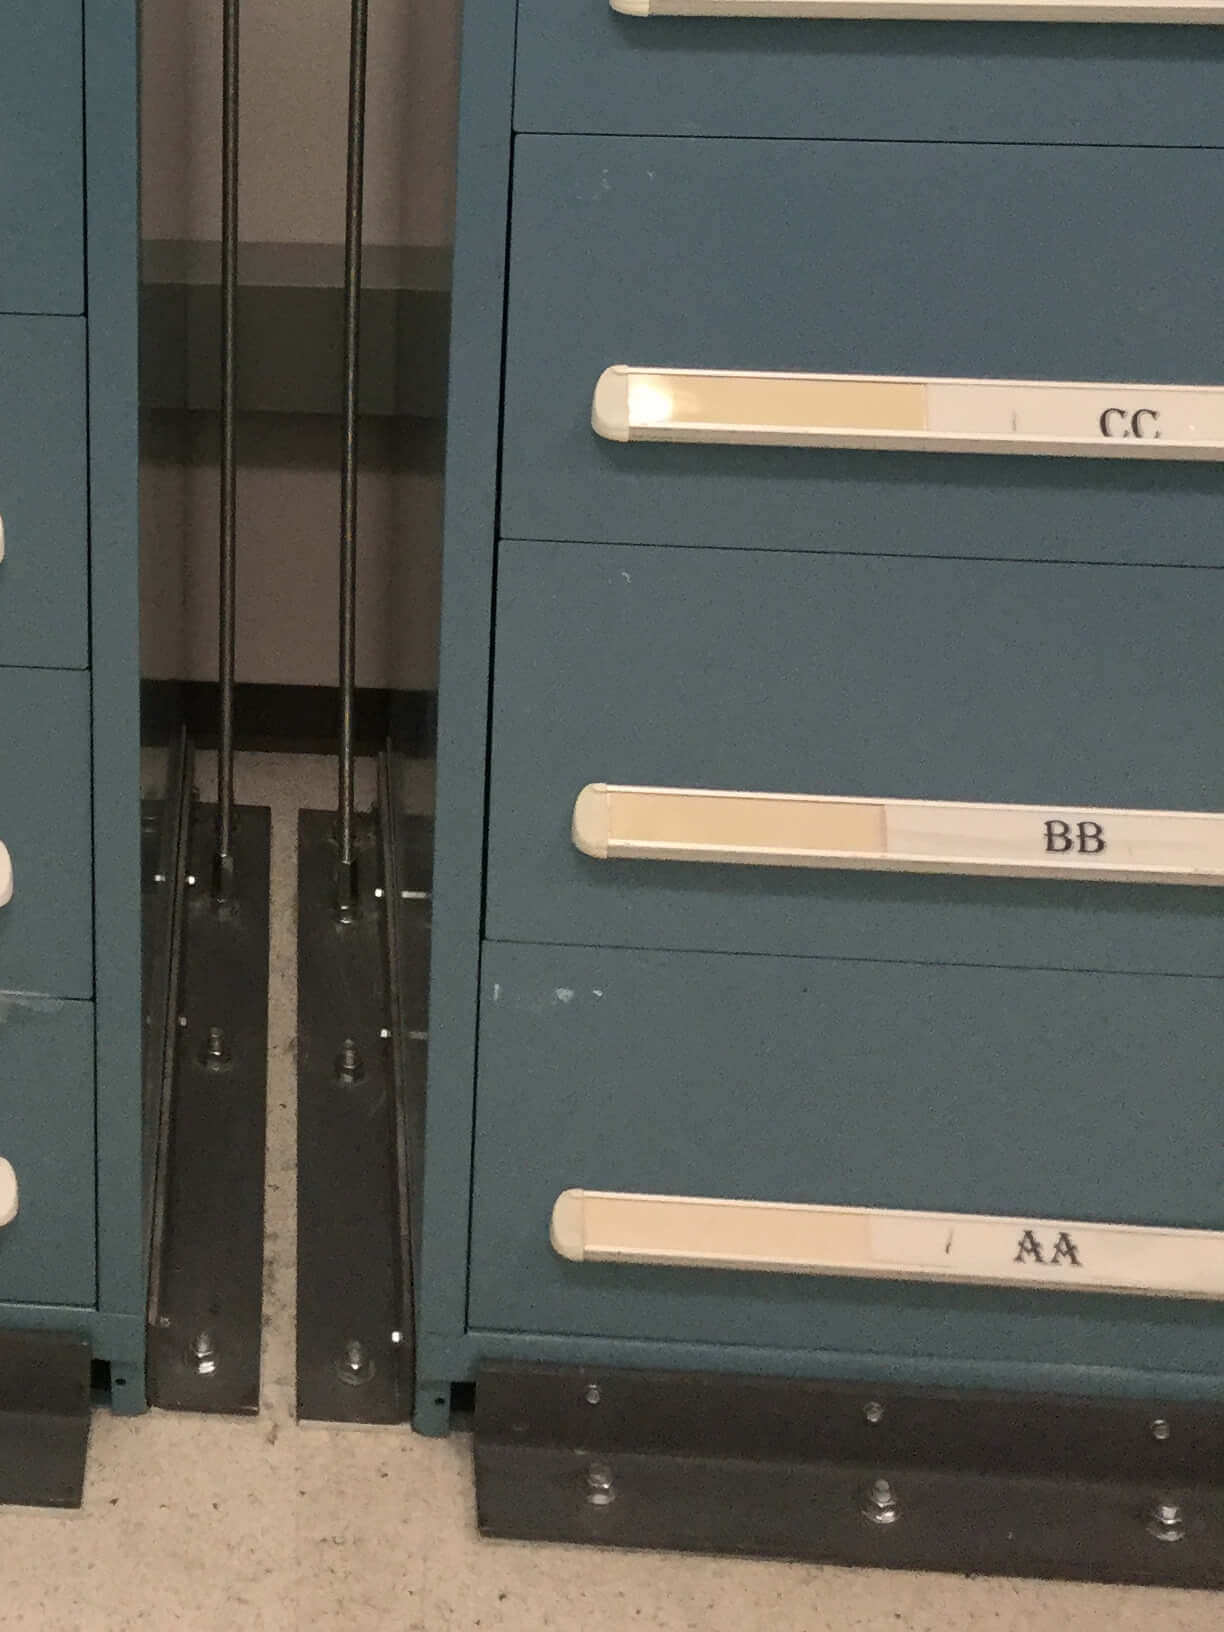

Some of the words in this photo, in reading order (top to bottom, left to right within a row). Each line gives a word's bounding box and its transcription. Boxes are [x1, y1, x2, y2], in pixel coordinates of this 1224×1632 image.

[1099, 408, 1160, 439] CC
[1043, 819, 1106, 853] BB
[1013, 1229, 1083, 1266] AA
